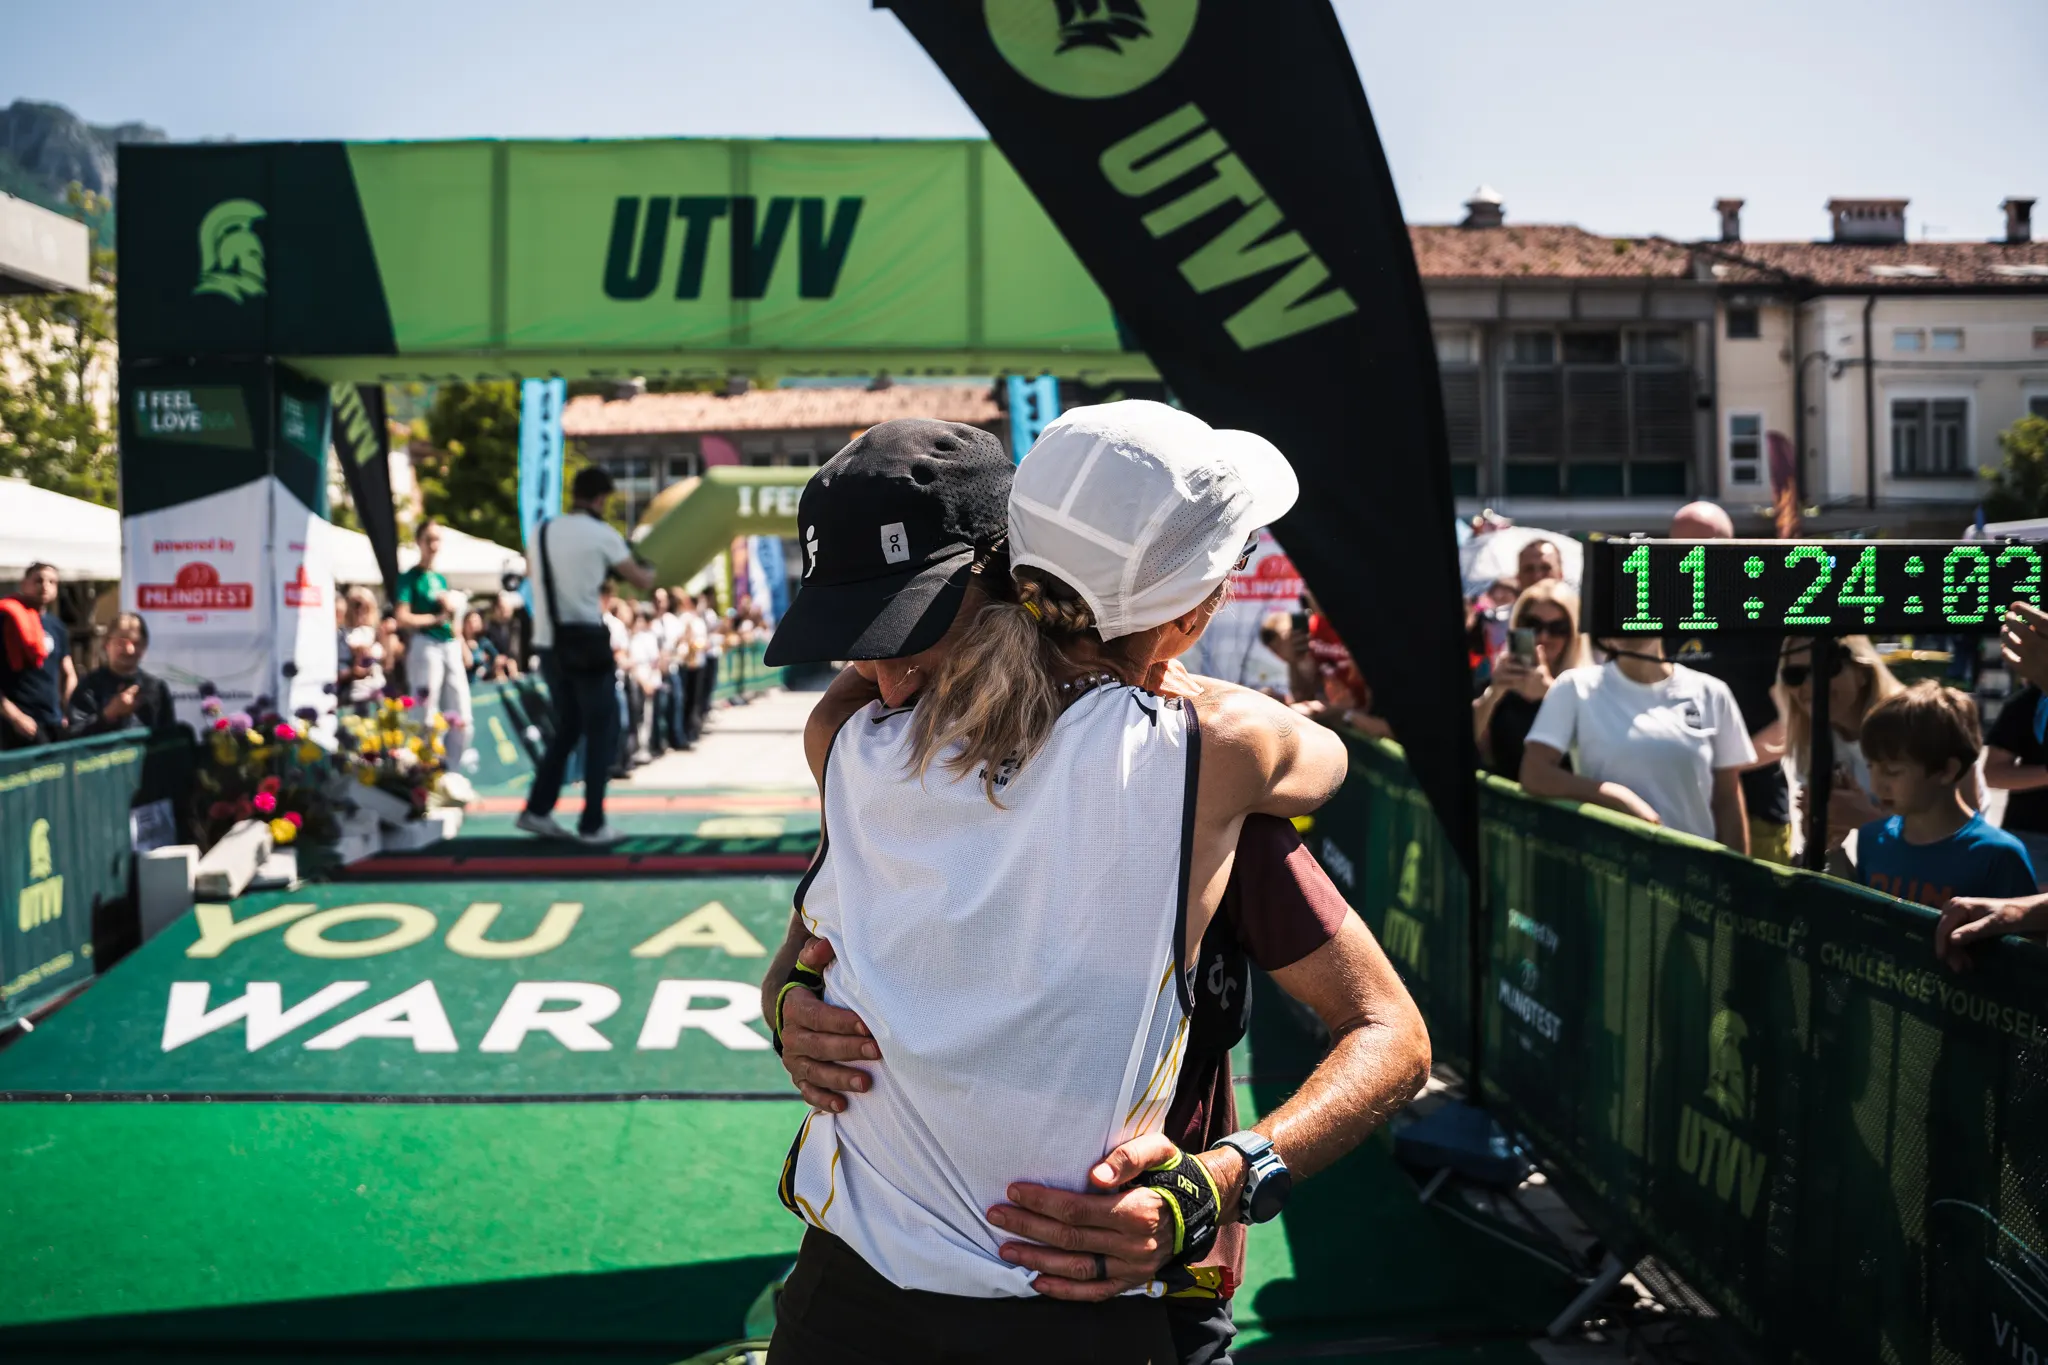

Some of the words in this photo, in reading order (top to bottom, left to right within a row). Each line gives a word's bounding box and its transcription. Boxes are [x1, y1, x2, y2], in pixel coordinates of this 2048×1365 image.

[602, 196, 865, 301] UTVV
[1098, 102, 1359, 351] UTVV
[151, 389, 196, 411] FEEL
[737, 486, 755, 517] I
[758, 486, 804, 517] FE
[185, 902, 585, 958] YOU
[1819, 941, 1933, 1004] CHALLENGE
[161, 980, 775, 1053] WARR
[1177, 1173, 1200, 1199] LEKI
[1678, 1104, 1767, 1220] UTVV
[1991, 1311, 2048, 1365] Vip
